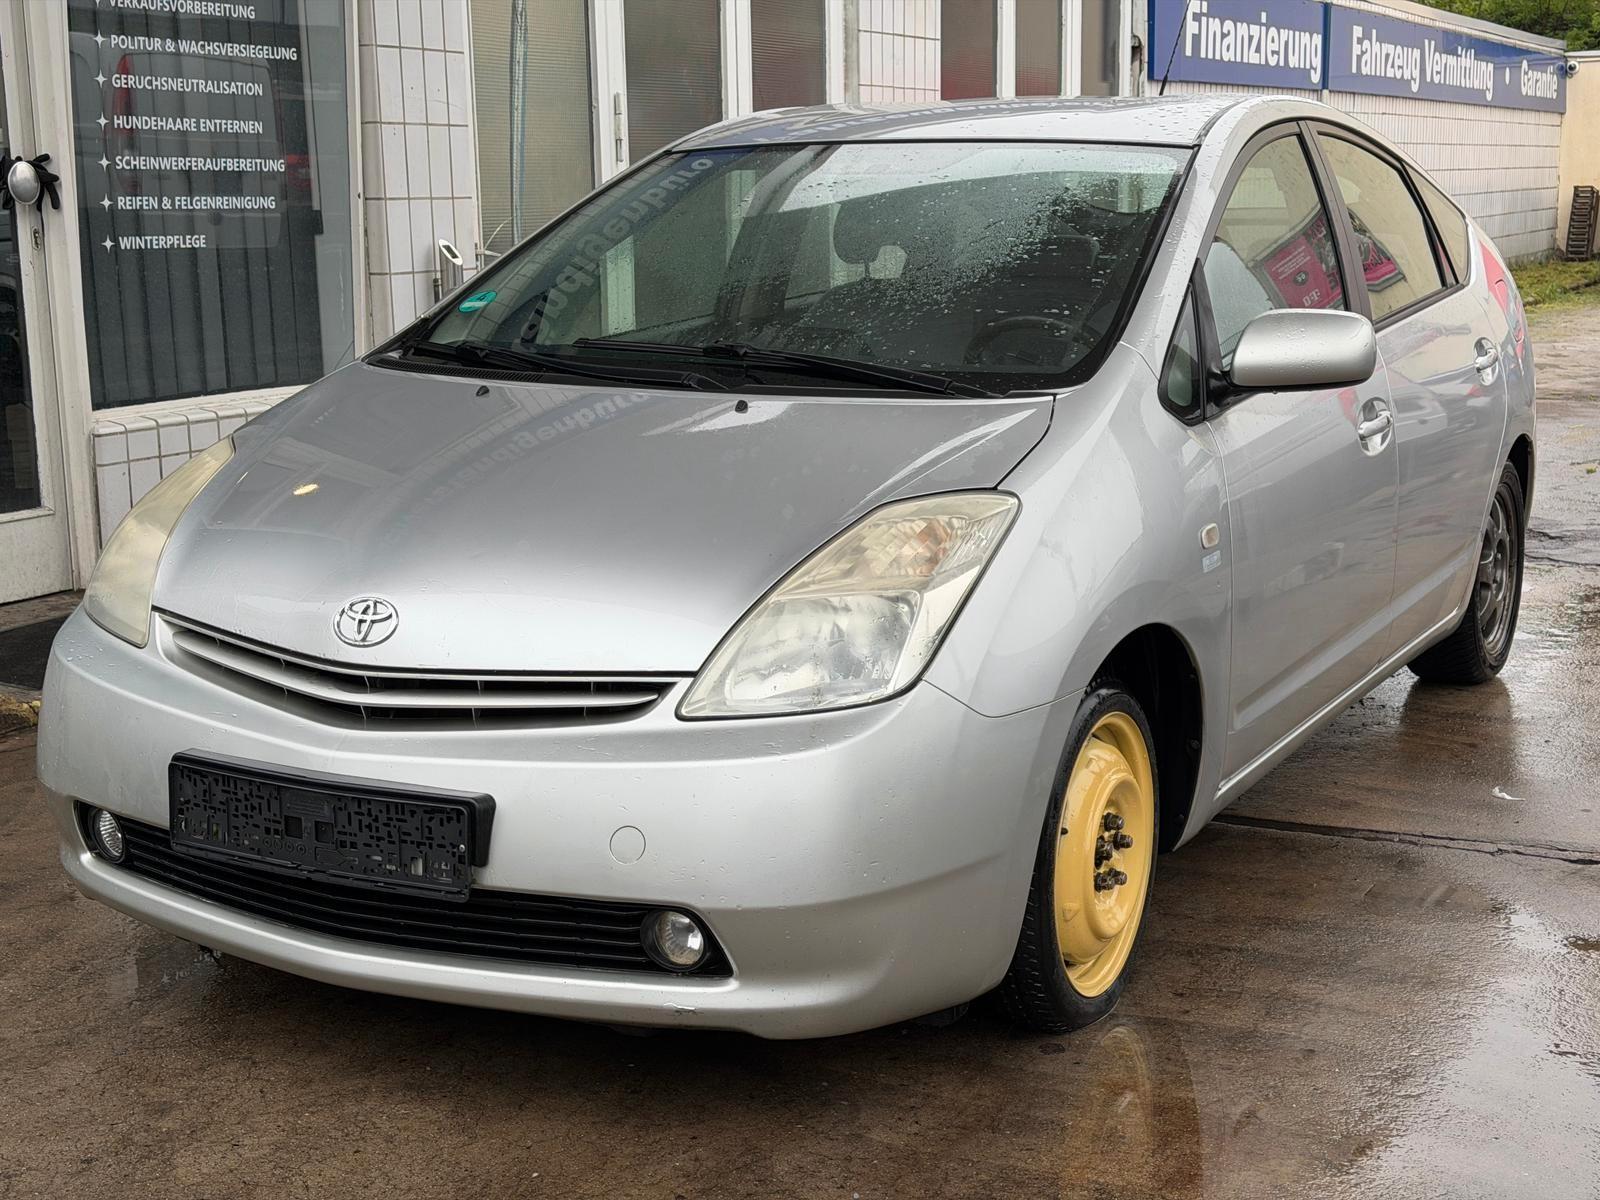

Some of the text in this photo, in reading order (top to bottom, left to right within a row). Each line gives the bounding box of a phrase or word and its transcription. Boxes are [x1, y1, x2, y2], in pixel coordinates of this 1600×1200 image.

[110, 34, 297, 60] POLITUR & WACHSVERSIEGELUNG
[1185, 5, 1322, 84] Finanzierung
[1352, 25, 1494, 101] Fahrzeug Vermittlung
[111, 73, 263, 96] GERUCHSNEUTRALISATION
[1520, 59, 1558, 100] Garantie
[113, 115, 263, 134] HUNDEHAARE ENTFERNEN
[115, 155, 285, 172] SCHEINWERFERAUFBEREITUNG
[117, 196, 276, 210] REIFEN & FELGENREINIGUNG
[118, 235, 207, 250] WINTERPFLEGE
